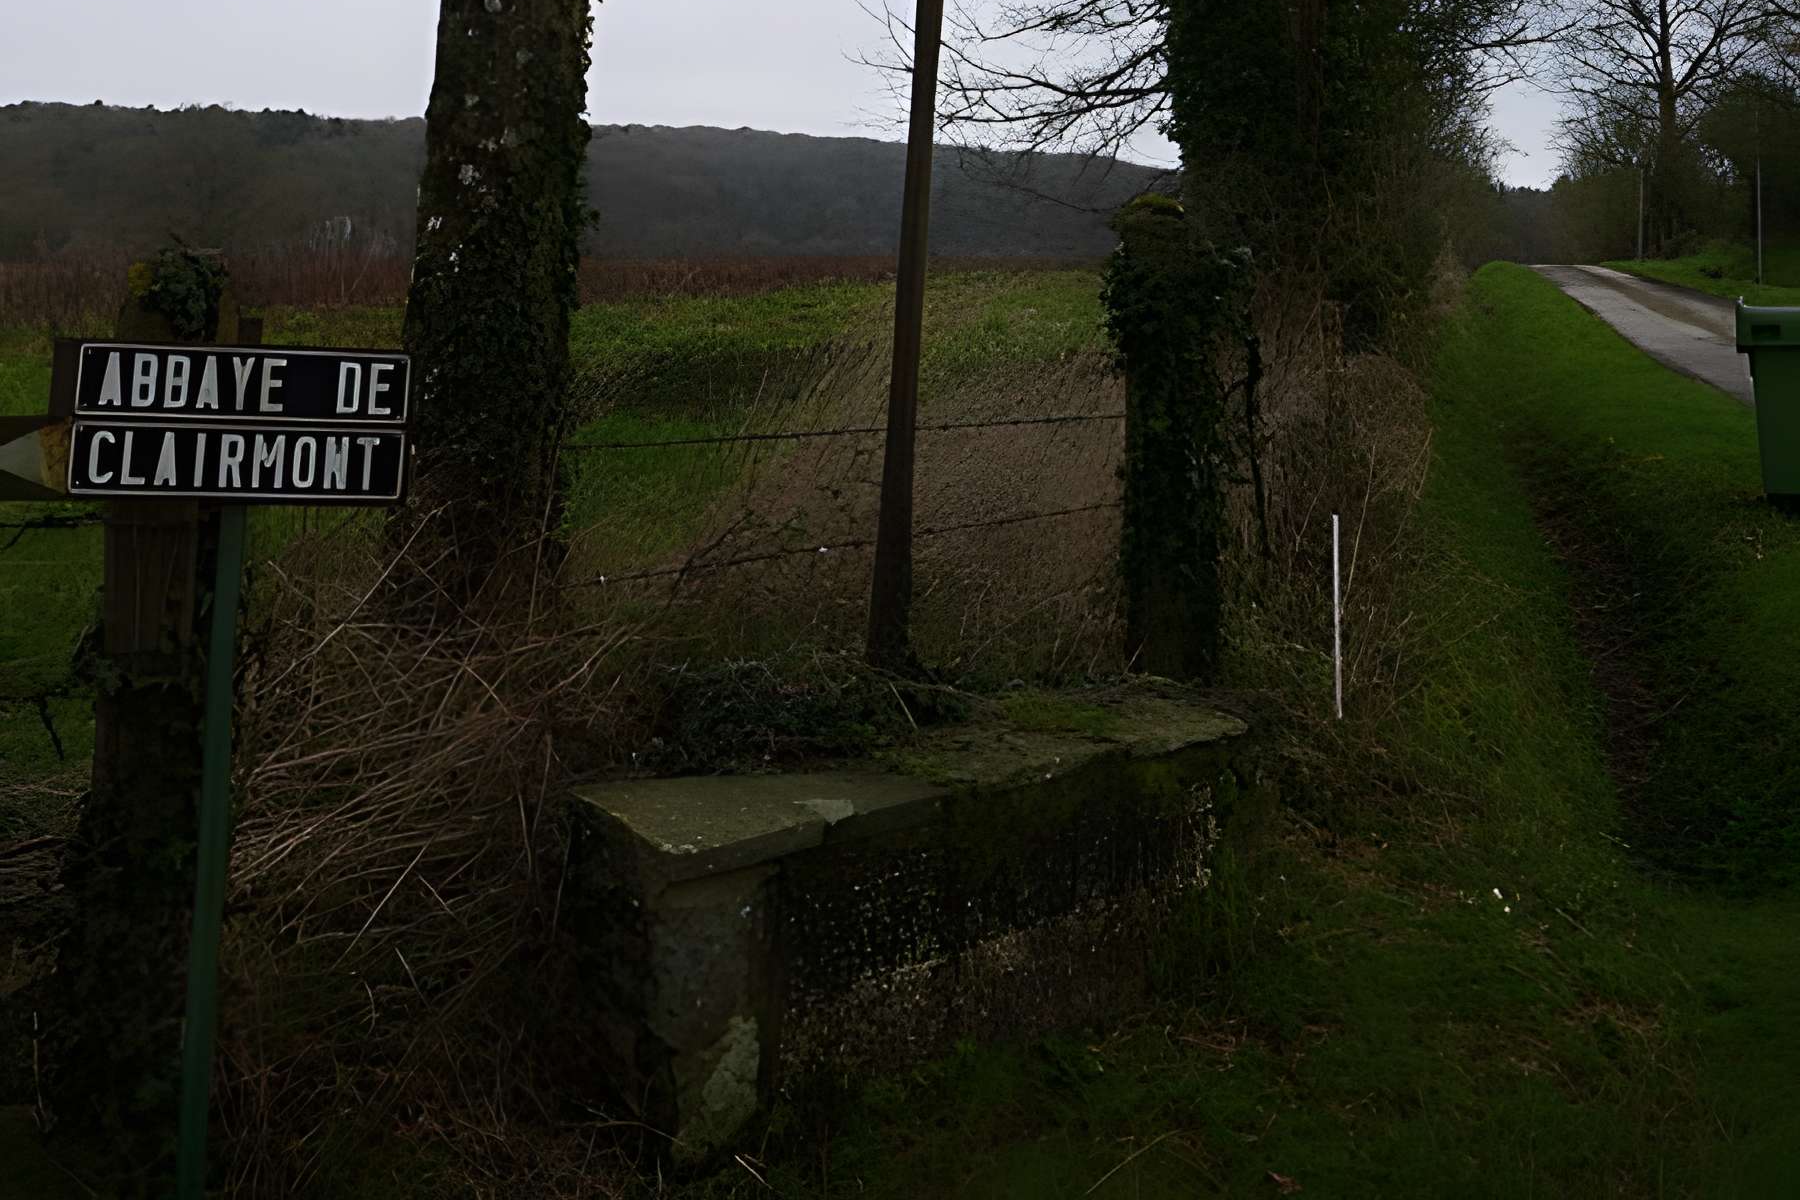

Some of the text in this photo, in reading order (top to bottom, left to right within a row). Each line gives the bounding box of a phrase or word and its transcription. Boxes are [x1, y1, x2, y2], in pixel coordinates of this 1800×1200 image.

[98, 351, 395, 416] ABBAYE DE
[87, 430, 381, 491] CLAIRMONT
